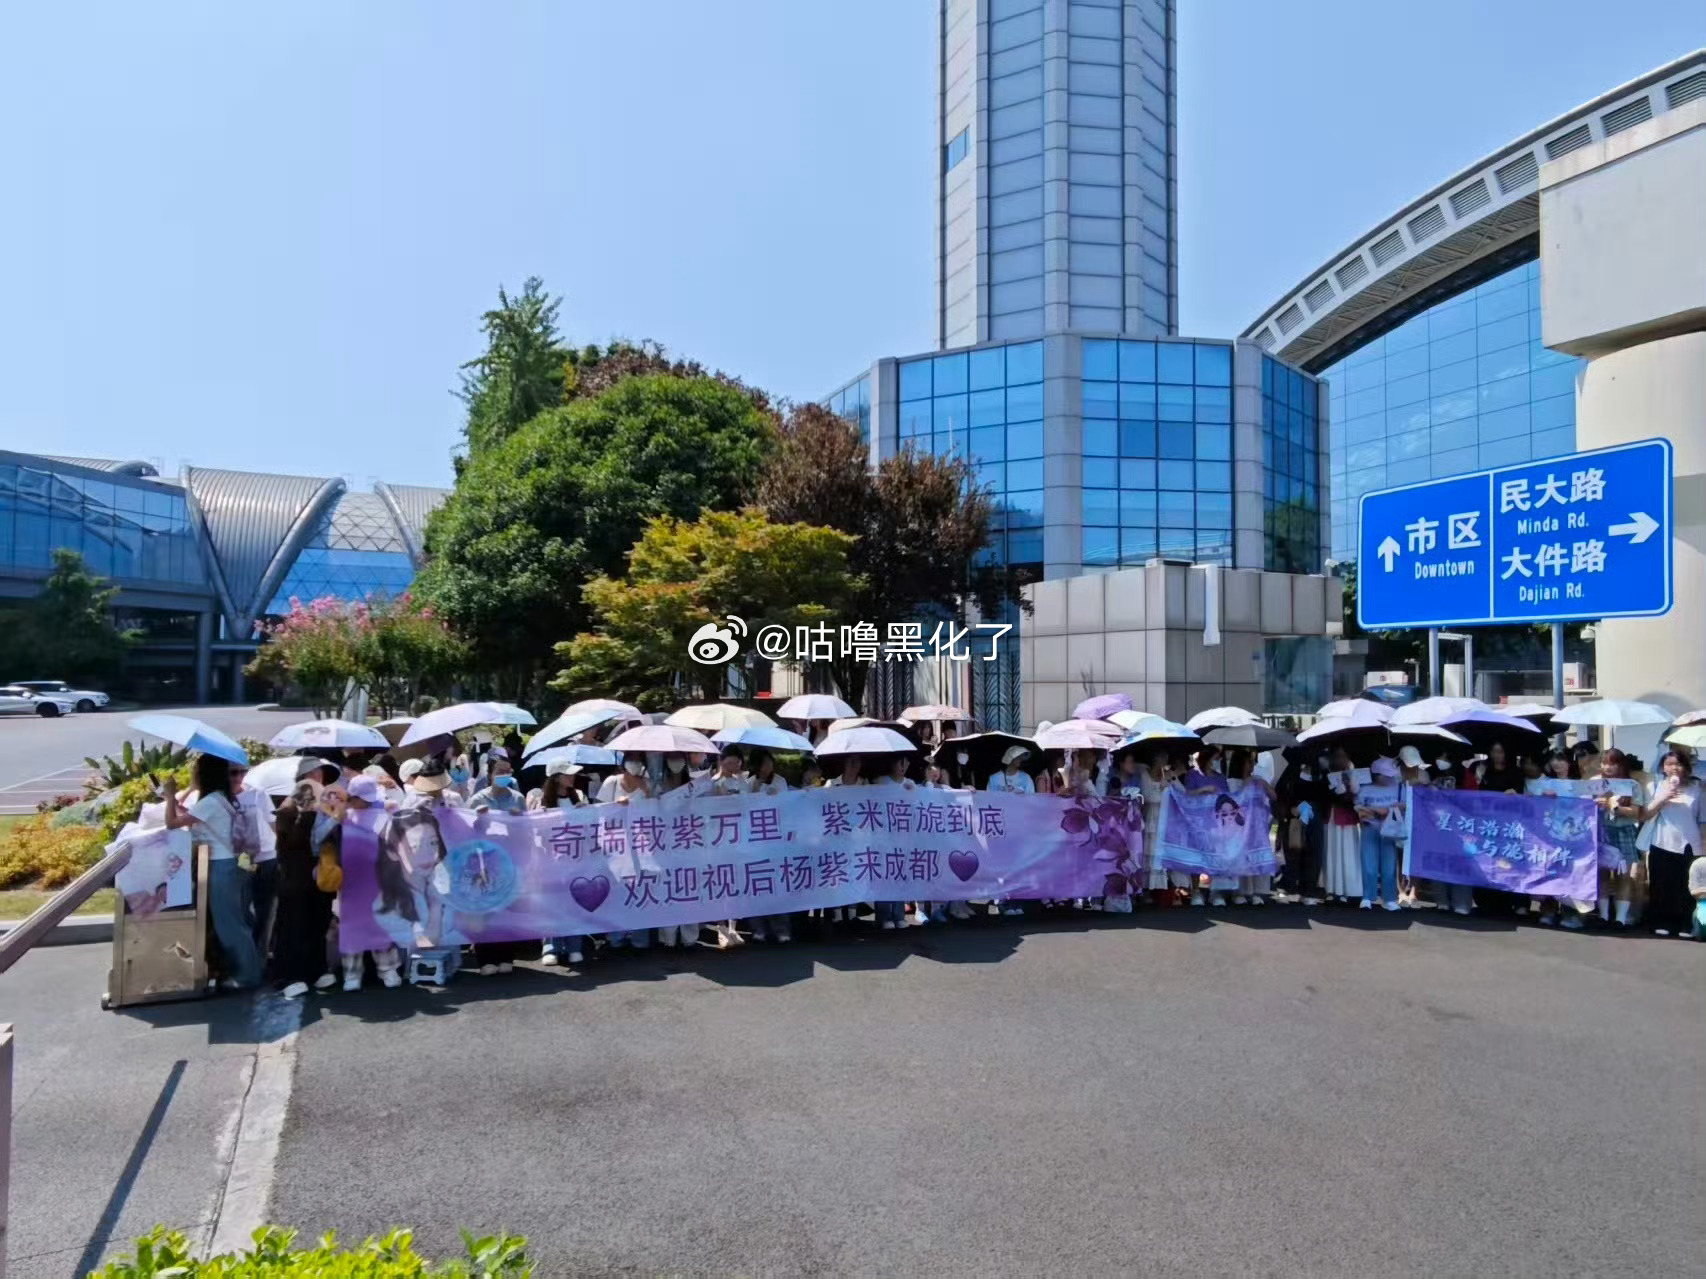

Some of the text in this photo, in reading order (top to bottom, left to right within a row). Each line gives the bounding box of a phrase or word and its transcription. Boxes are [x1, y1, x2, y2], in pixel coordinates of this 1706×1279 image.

[1500, 467, 1606, 514] 民大路
[1405, 511, 1481, 555] 市区
[1517, 512, 1589, 536] Minda Rd.
[1414, 560, 1475, 580] Downtown
[1501, 539, 1607, 580] 大件路
[1519, 583, 1585, 605] Dajian Rd.
[620, 846, 940, 908] 欢迎视后杨紫来成都
